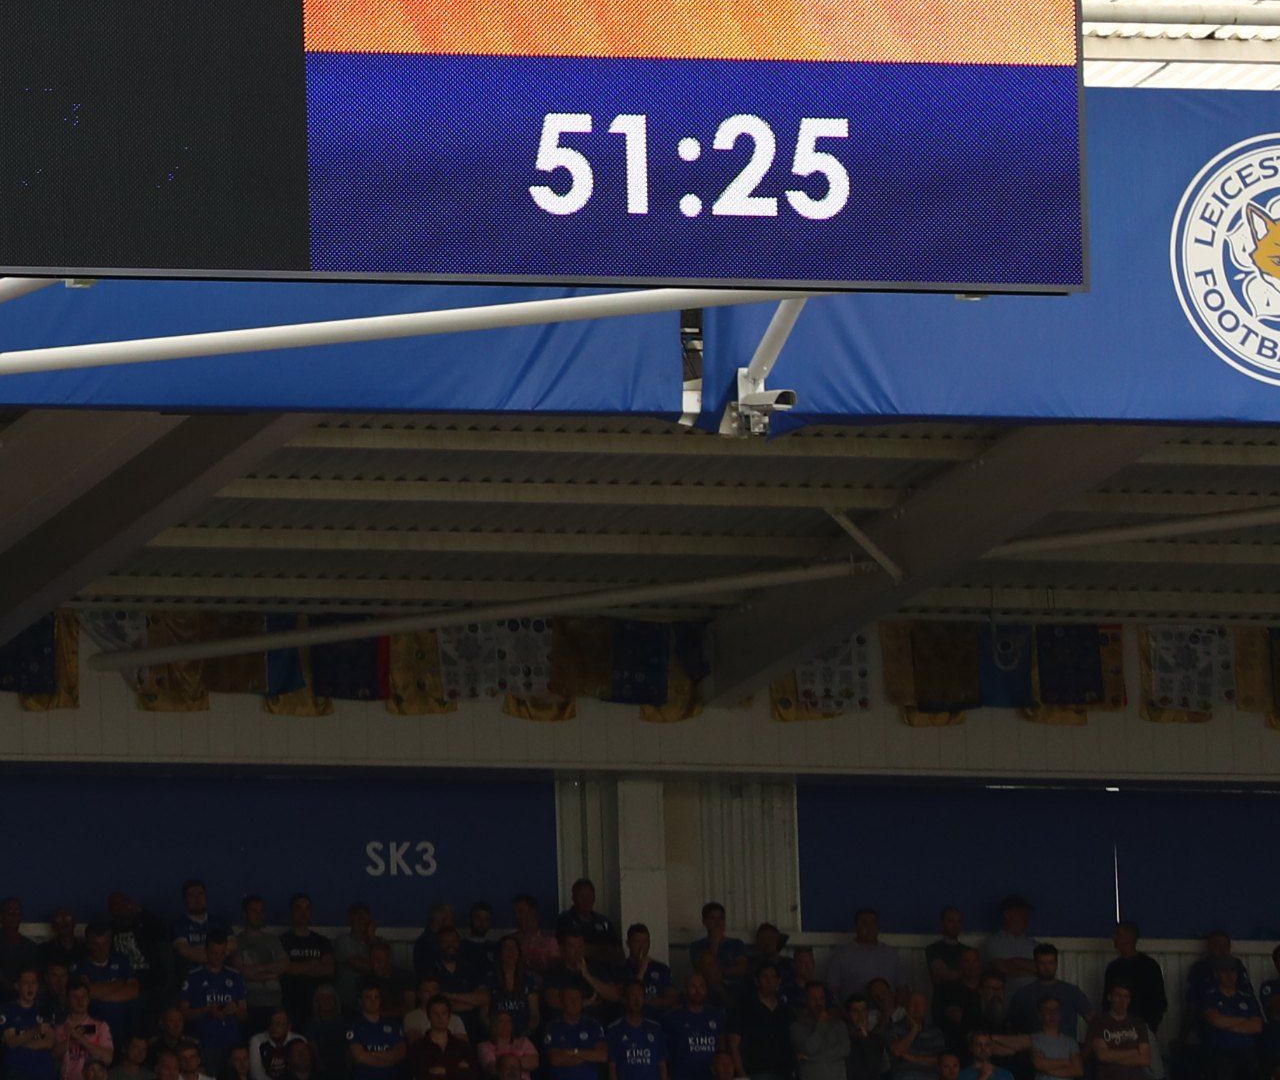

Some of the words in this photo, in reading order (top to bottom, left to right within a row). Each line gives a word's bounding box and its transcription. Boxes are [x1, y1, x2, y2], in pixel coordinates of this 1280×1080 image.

[529, 113, 851, 220] 51:25
[1194, 156, 1280, 248] LEICES
[1194, 268, 1280, 361] FOOTB
[364, 839, 437, 876] SK3
[206, 993, 232, 1003] KING
[626, 1048, 651, 1058] KING
[688, 1036, 715, 1045] KING
